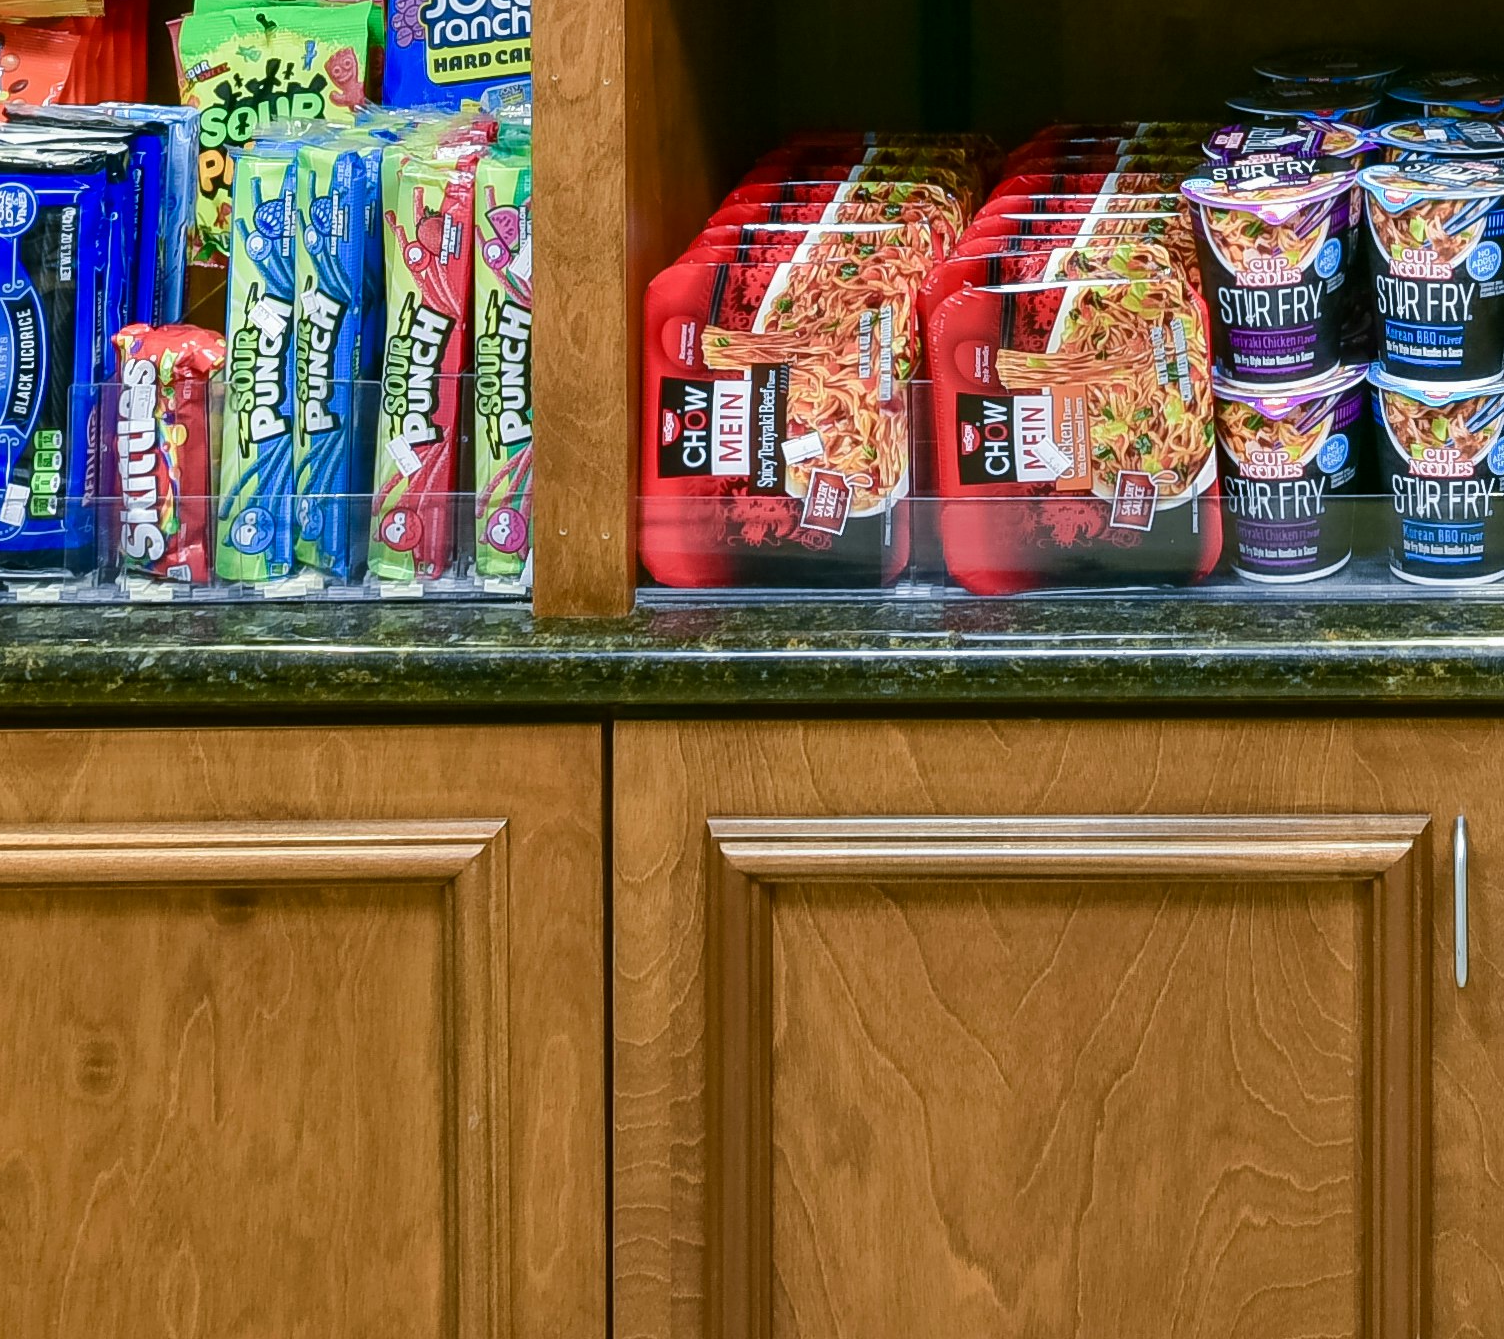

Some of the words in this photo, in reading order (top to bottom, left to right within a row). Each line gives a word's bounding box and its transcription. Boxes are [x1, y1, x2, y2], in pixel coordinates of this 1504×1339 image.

[1388, 262, 1453, 280] NOODLES
[1402, 249, 1439, 266] CUP
[15, 309, 32, 358] LICORICE
[15, 360, 29, 415] BLACK
[385, 337, 412, 412] SOUR
[402, 308, 455, 444] PUNCH
[682, 386, 708, 468] CHOW
[718, 392, 744, 463] MEIN
